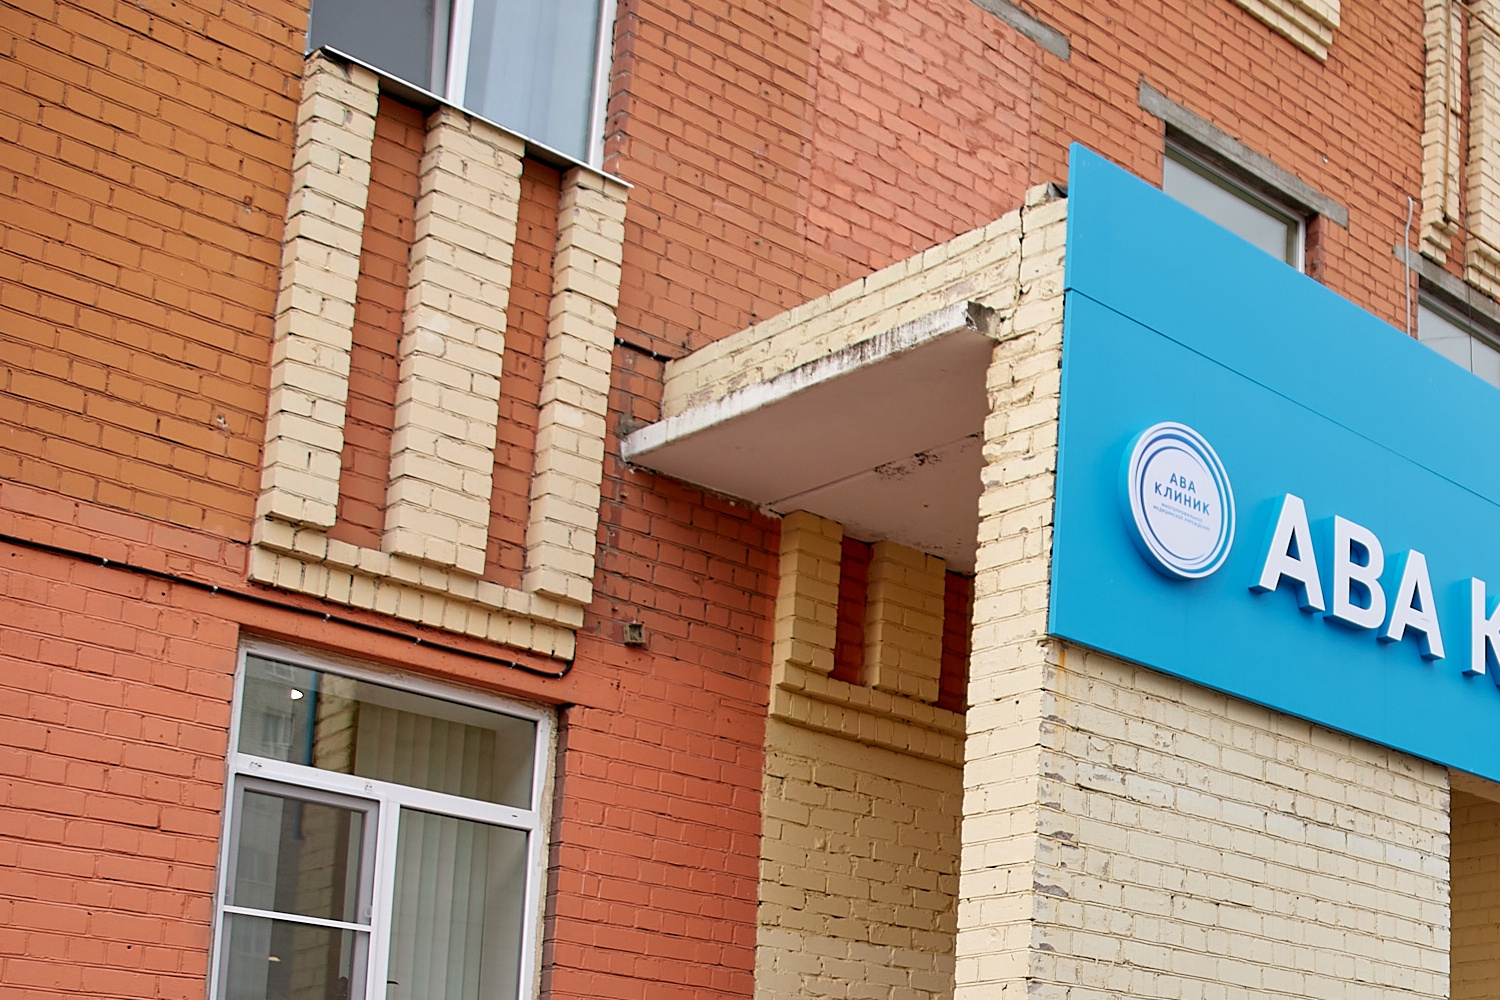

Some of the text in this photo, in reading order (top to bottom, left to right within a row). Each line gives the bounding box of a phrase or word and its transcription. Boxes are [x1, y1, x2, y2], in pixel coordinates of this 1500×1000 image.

[1154, 481, 1210, 516] КЛИНИК
[1170, 472, 1196, 494] АВА
[1250, 492, 1446, 661] АВА
